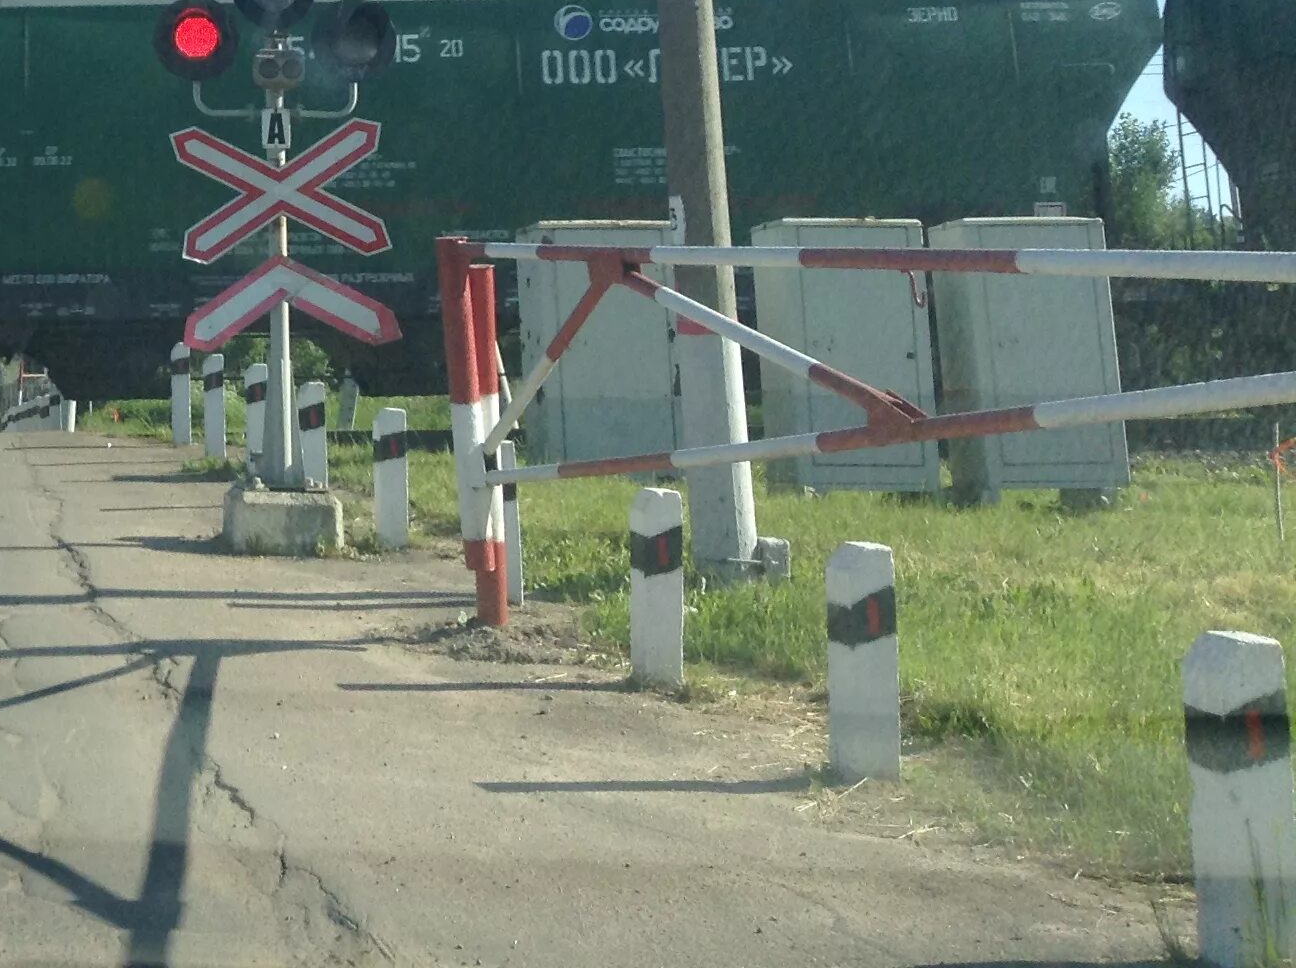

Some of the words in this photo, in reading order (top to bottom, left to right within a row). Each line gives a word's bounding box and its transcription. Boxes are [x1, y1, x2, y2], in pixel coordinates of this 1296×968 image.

[906, 7, 958, 22] ЗЕРНО
[439, 39, 463, 58] 20
[267, 113, 286, 144] А
